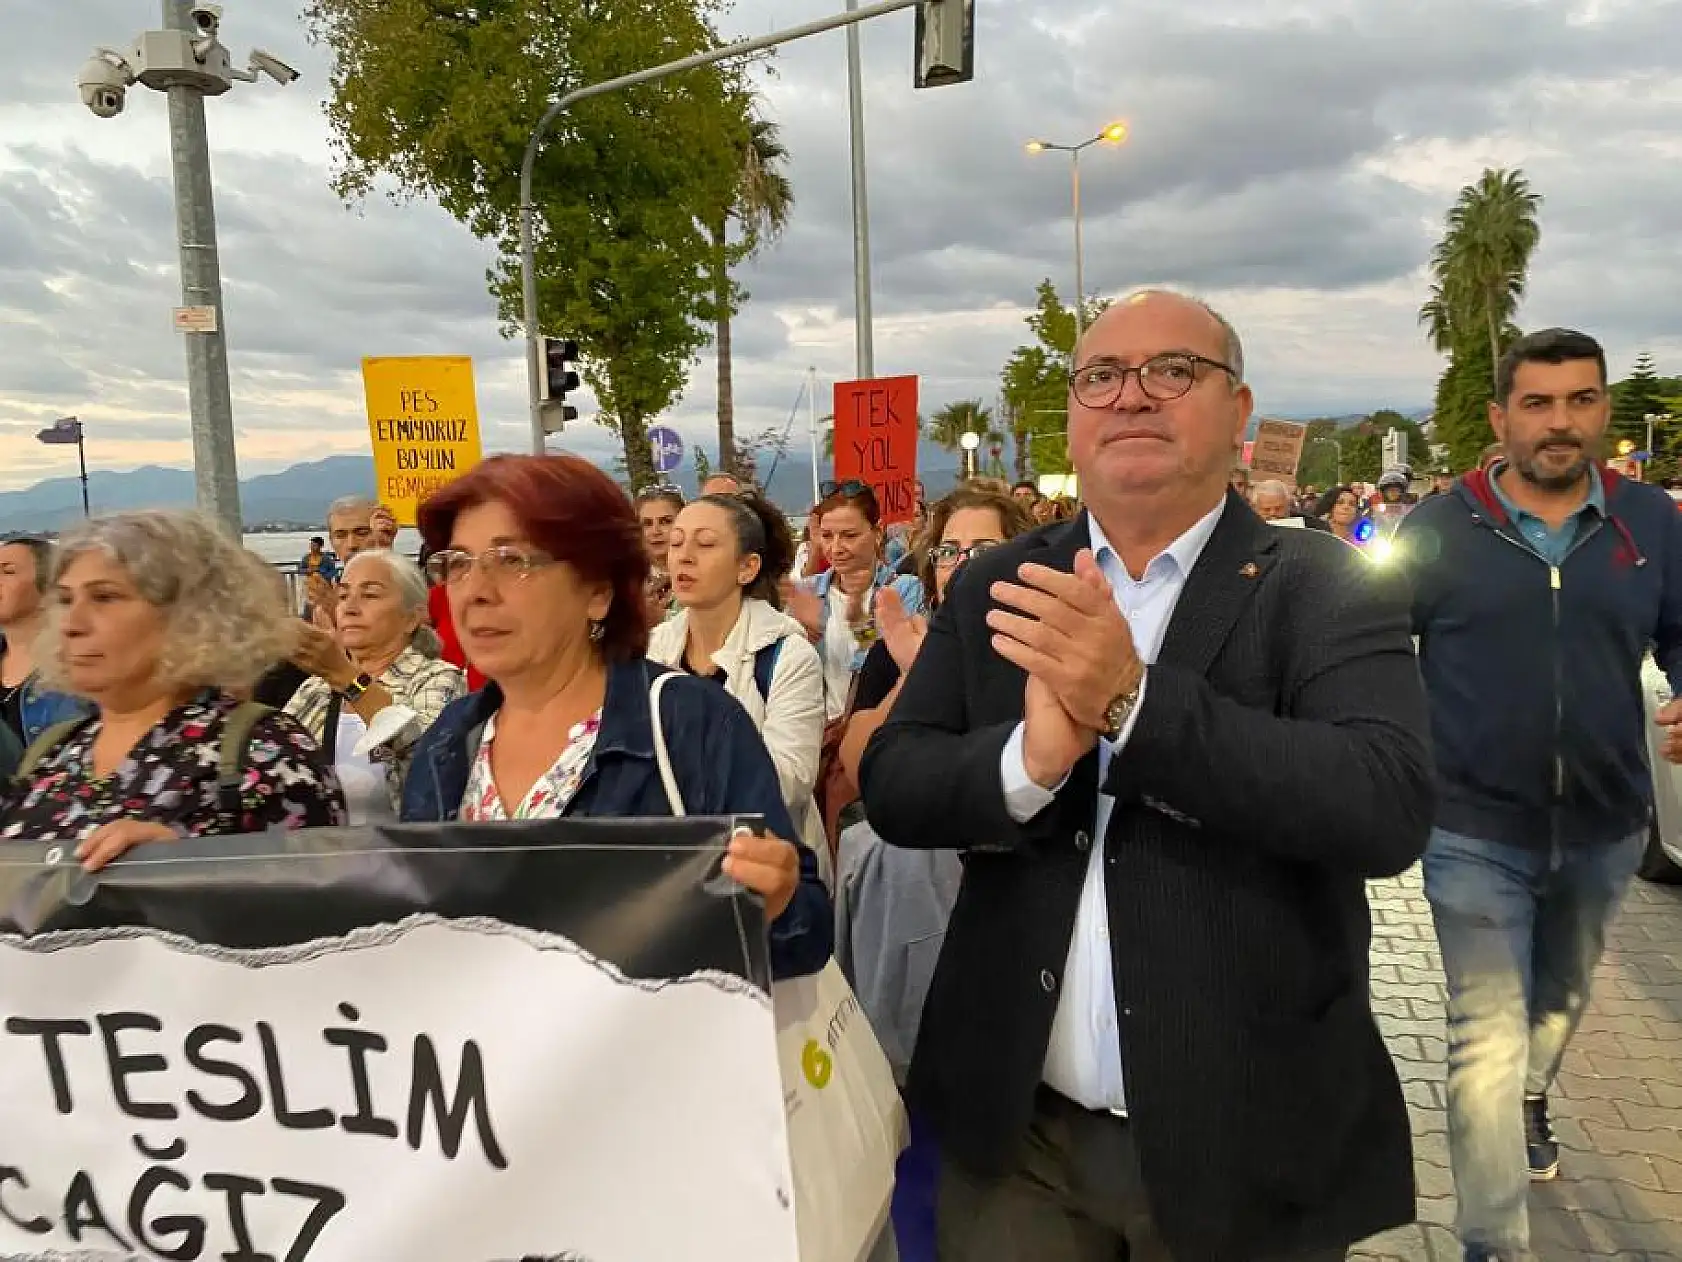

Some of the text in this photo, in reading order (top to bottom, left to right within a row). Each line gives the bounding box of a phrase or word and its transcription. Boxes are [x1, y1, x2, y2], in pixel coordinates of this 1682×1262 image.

[400, 389, 438, 413] PES
[851, 389, 901, 427] TEK
[376, 415, 468, 443] ETMİYORUZ
[397, 447, 456, 470] BOYUN
[853, 437, 898, 473] YOL
[5, 1001, 508, 1170] TESLİM
